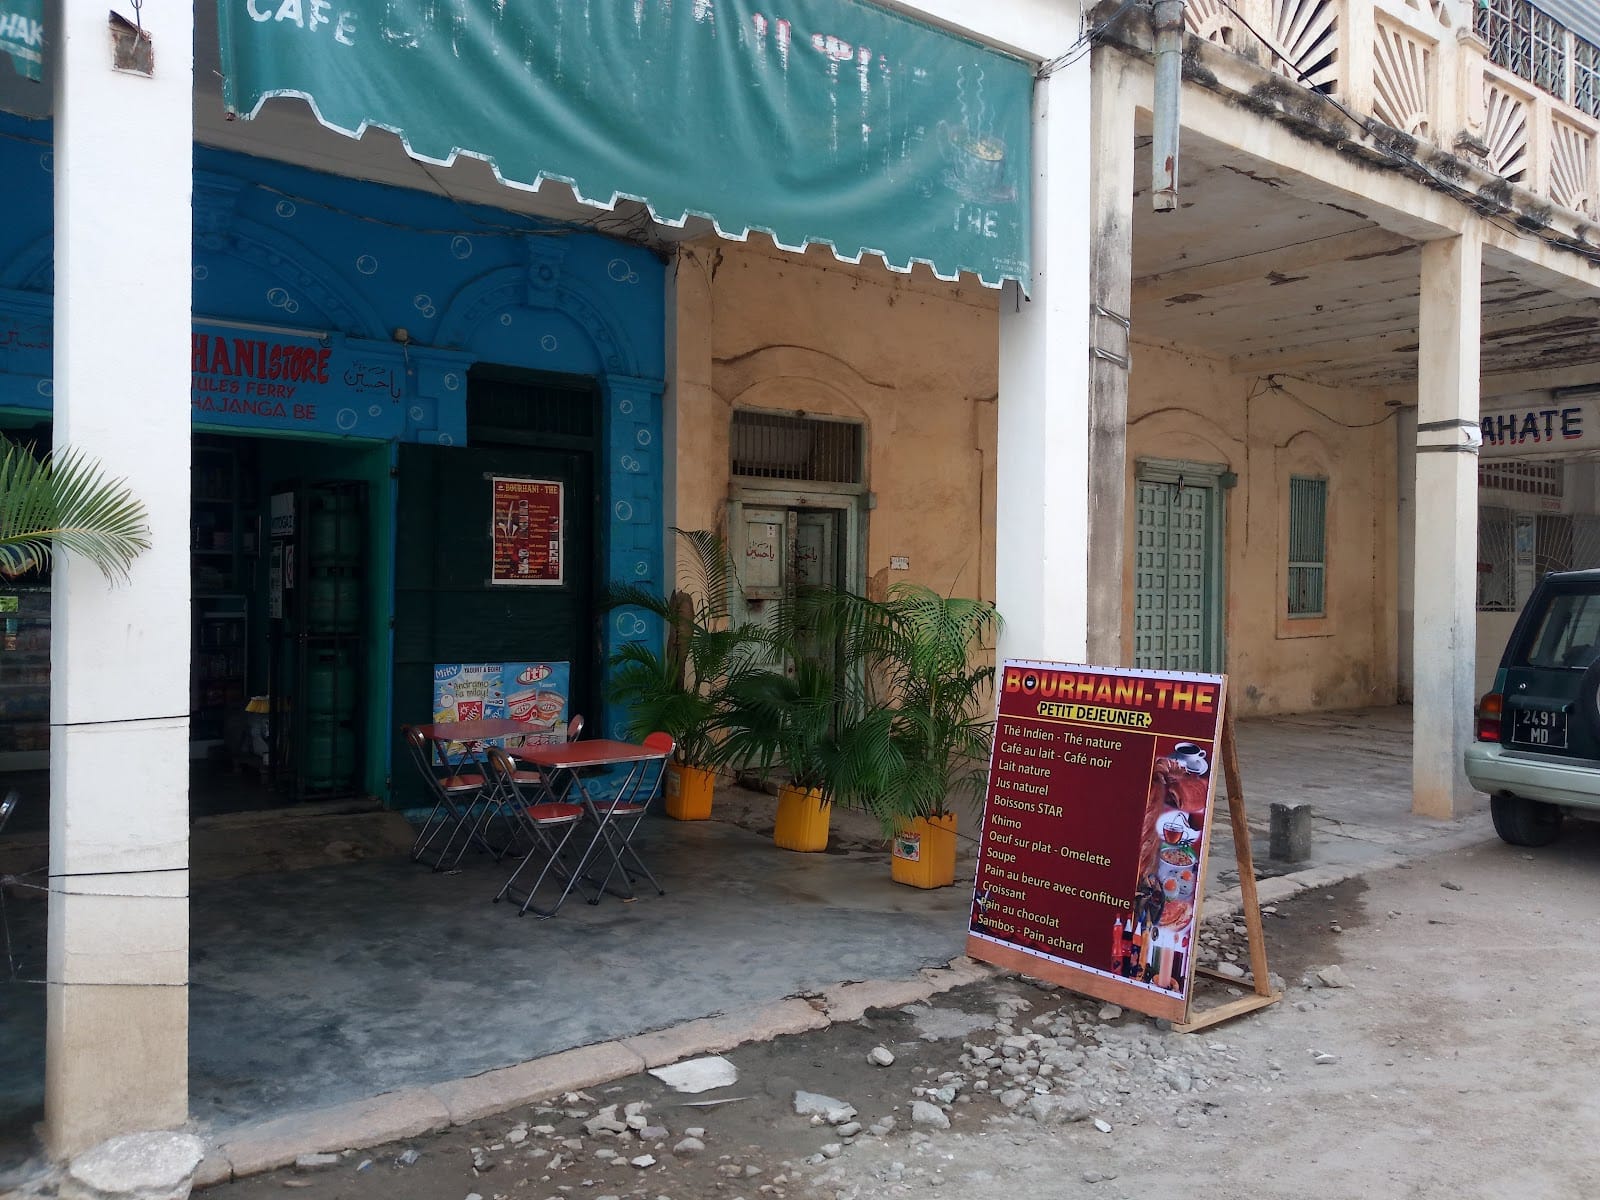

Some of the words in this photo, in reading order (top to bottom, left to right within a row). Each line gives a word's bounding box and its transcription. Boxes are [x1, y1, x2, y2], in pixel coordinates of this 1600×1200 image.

[247, 0, 355, 46] CAFE
[269, 344, 333, 384] STORE
[246, 382, 297, 399] FERRY
[294, 403, 317, 420] BE
[505, 483, 539, 493] BOURHANI
[1004, 667, 1215, 714] BOURHANI-THE
[1039, 702, 1074, 718] PETIT
[1076, 706, 1151, 728] DEJEUNER:
[1522, 710, 1556, 727] 2491
[1003, 724, 1020, 736] Thé
[1023, 727, 1054, 741] Indien
[1064, 732, 1083, 745] Thé
[1085, 736, 1122, 751] nature
[1530, 728, 1549, 744] MD
[1001, 741, 1022, 755] Café
[1024, 747, 1036, 757] au
[1038, 746, 1055, 760] lait
[1064, 751, 1087, 765] Café
[1090, 754, 1112, 768] noir
[998, 759, 1015, 772] Lait
[1018, 763, 1051, 777] nature
[995, 777, 1011, 789] Jus
[1013, 781, 1049, 796] naturel
[994, 795, 1035, 813] Boissons
[1038, 802, 1063, 817] STAR
[991, 814, 1022, 829] Khimo
[986, 847, 1016, 864] Soupe
[989, 830, 1013, 845] Oeuf
[1014, 837, 1029, 847] sur
[1031, 840, 1051, 856] plat
[1060, 846, 1111, 867] Omelette
[982, 880, 1026, 901] Croissant
[984, 863, 1004, 877] Pain
[1007, 871, 1019, 881] au
[1021, 873, 1051, 890] beure
[1053, 882, 1077, 896] avec
[1079, 887, 1131, 909] confiture
[980, 896, 1000, 912] Pain
[1002, 905, 1015, 915] au
[1016, 907, 1060, 929] chocolat
[977, 913, 1015, 934] Sambos
[1023, 927, 1045, 944] Pain
[1047, 933, 1084, 954] achard
